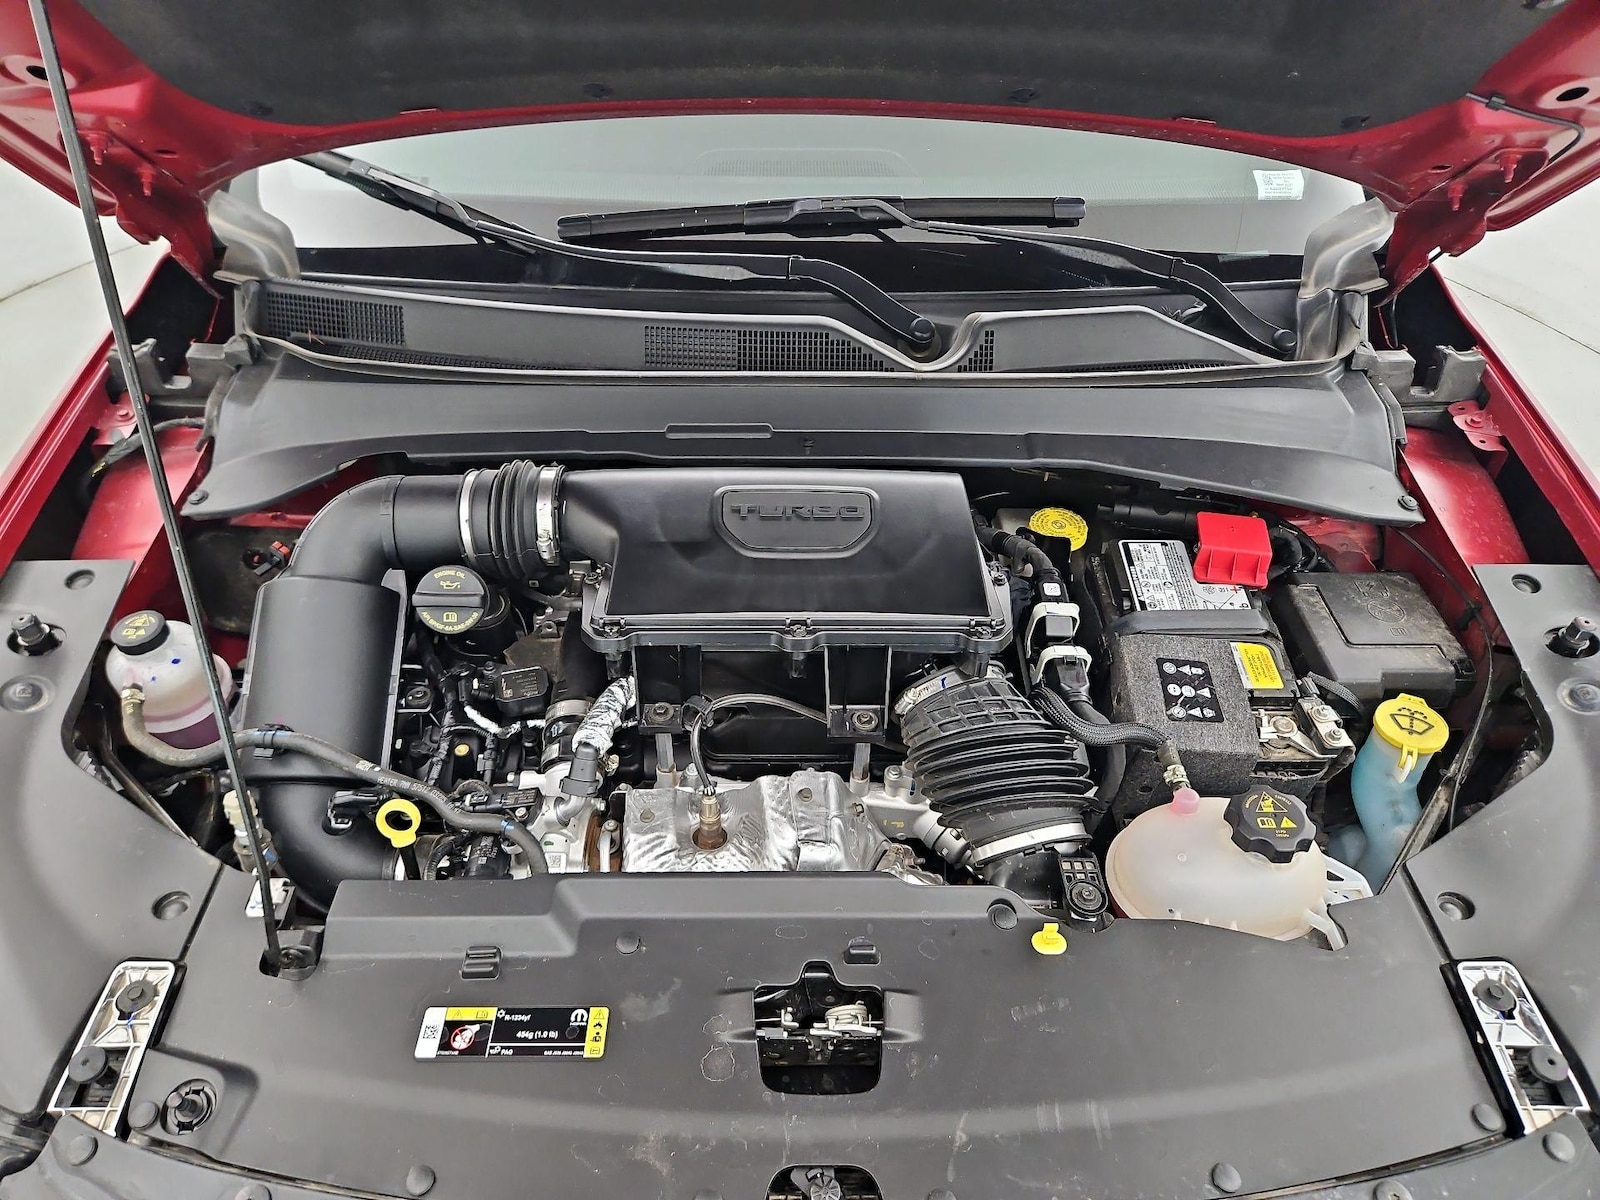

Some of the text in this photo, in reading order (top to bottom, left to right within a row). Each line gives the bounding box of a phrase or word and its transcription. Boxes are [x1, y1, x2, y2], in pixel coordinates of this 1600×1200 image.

[731, 505, 865, 521] TURBO
[434, 570, 466, 579] ENGINE OIL
[504, 1014, 531, 1022] R-1234yf
[516, 1030, 559, 1040] 454g (1.0 lb)
